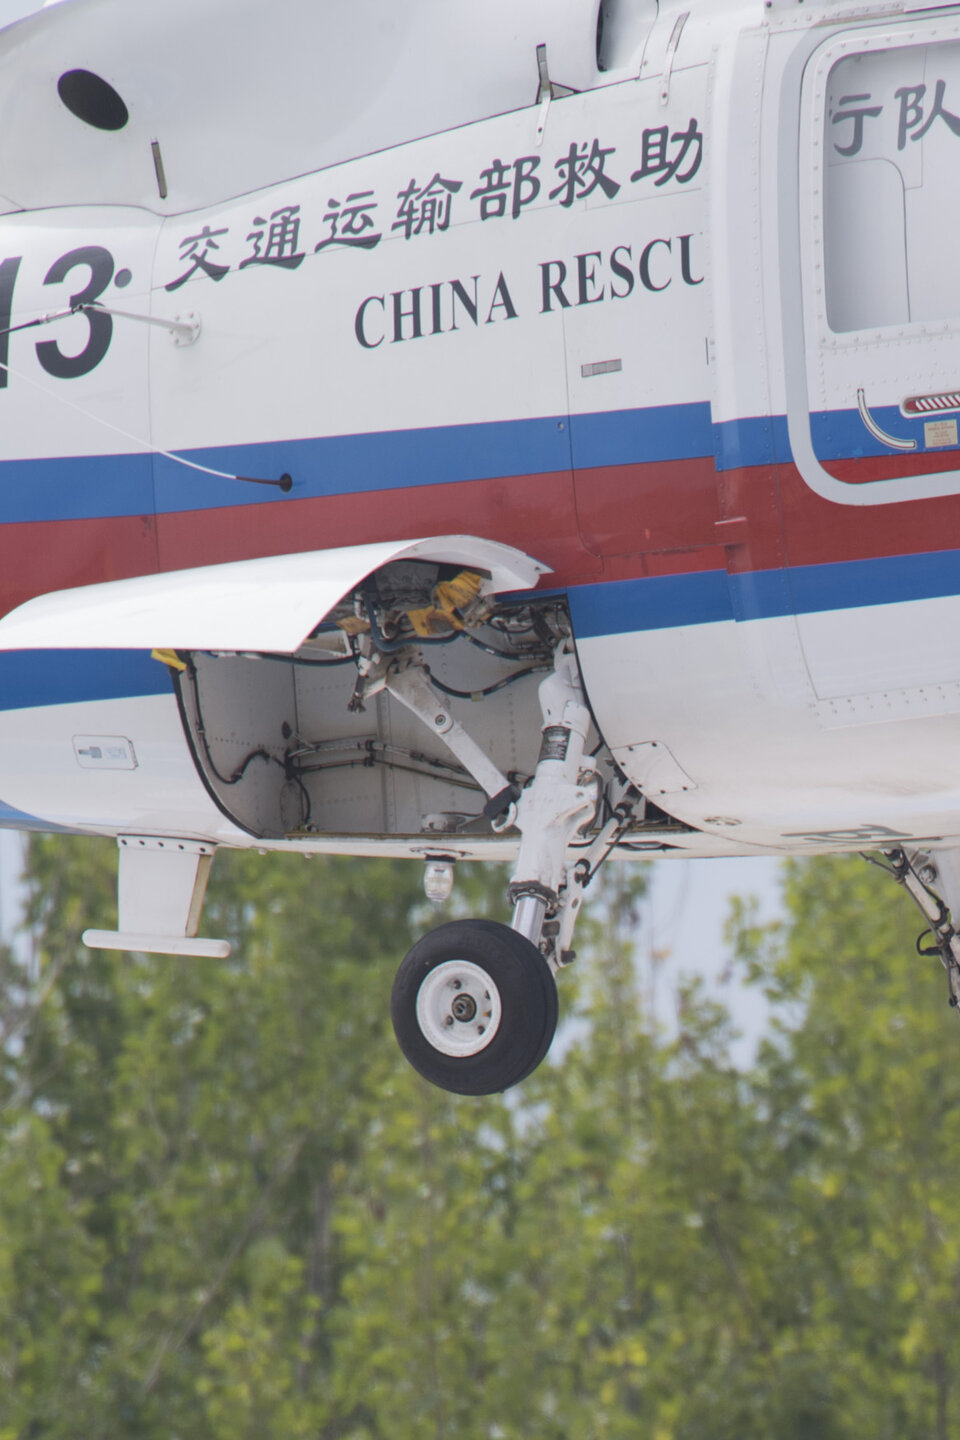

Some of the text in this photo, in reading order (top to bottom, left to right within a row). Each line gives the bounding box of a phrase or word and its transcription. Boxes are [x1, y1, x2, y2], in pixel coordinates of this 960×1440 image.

[165, 118, 703, 292] 交通运输部救助
[354, 270, 520, 349] CHINA
